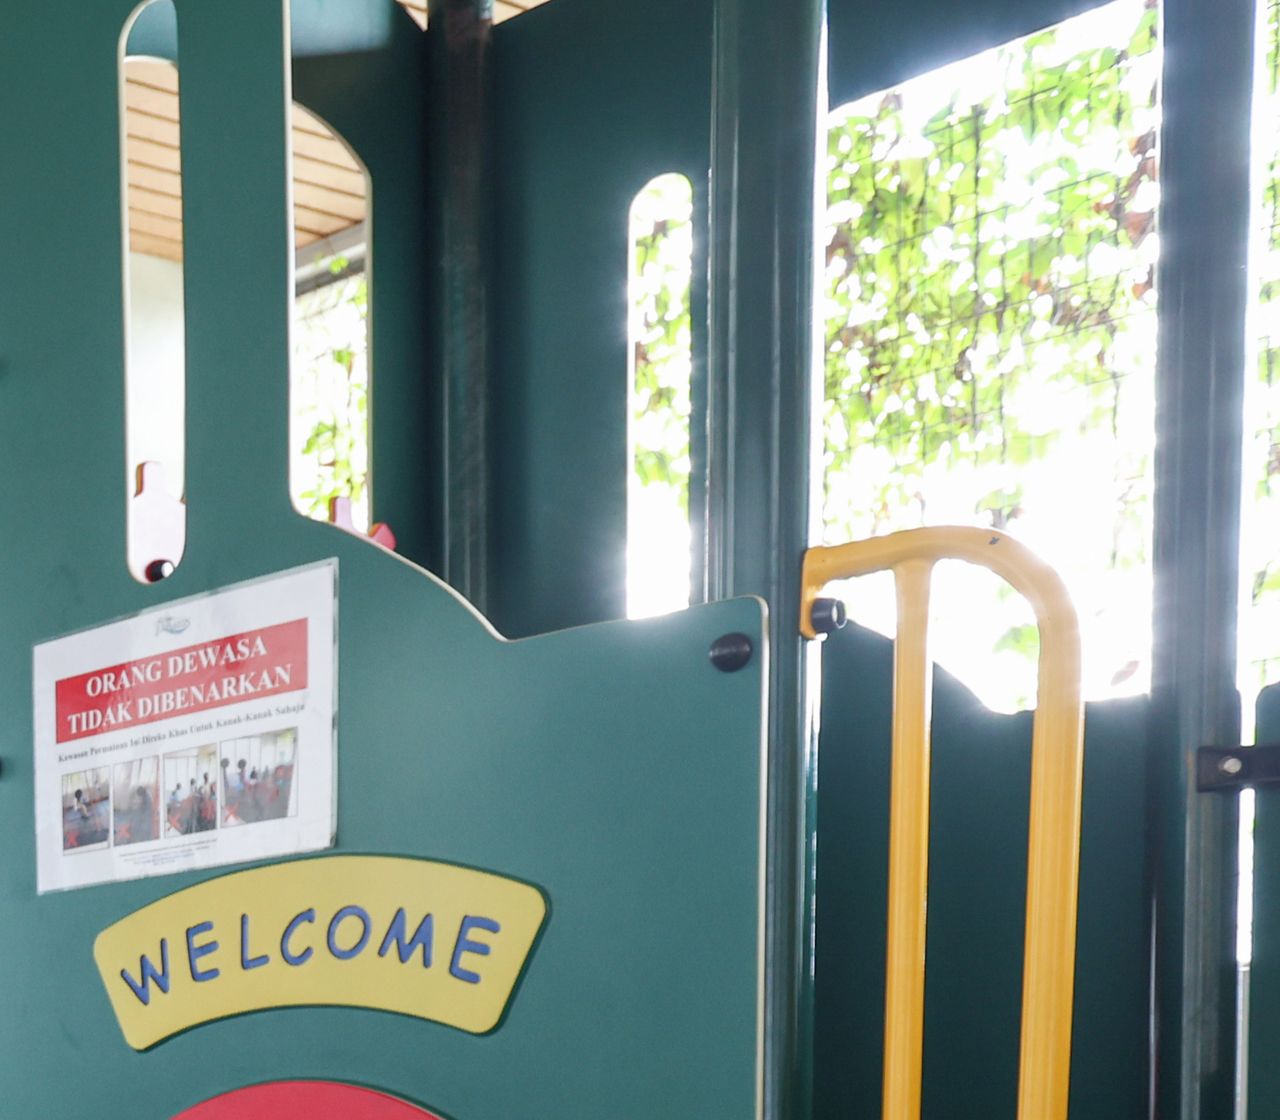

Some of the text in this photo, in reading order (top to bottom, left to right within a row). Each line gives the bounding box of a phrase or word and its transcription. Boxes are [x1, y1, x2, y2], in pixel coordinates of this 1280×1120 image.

[67, 663, 293, 735] TIDAK DIBENARKAN
[86, 636, 268, 698] ORANG DEWASA
[120, 905, 501, 1006] WELCOME
